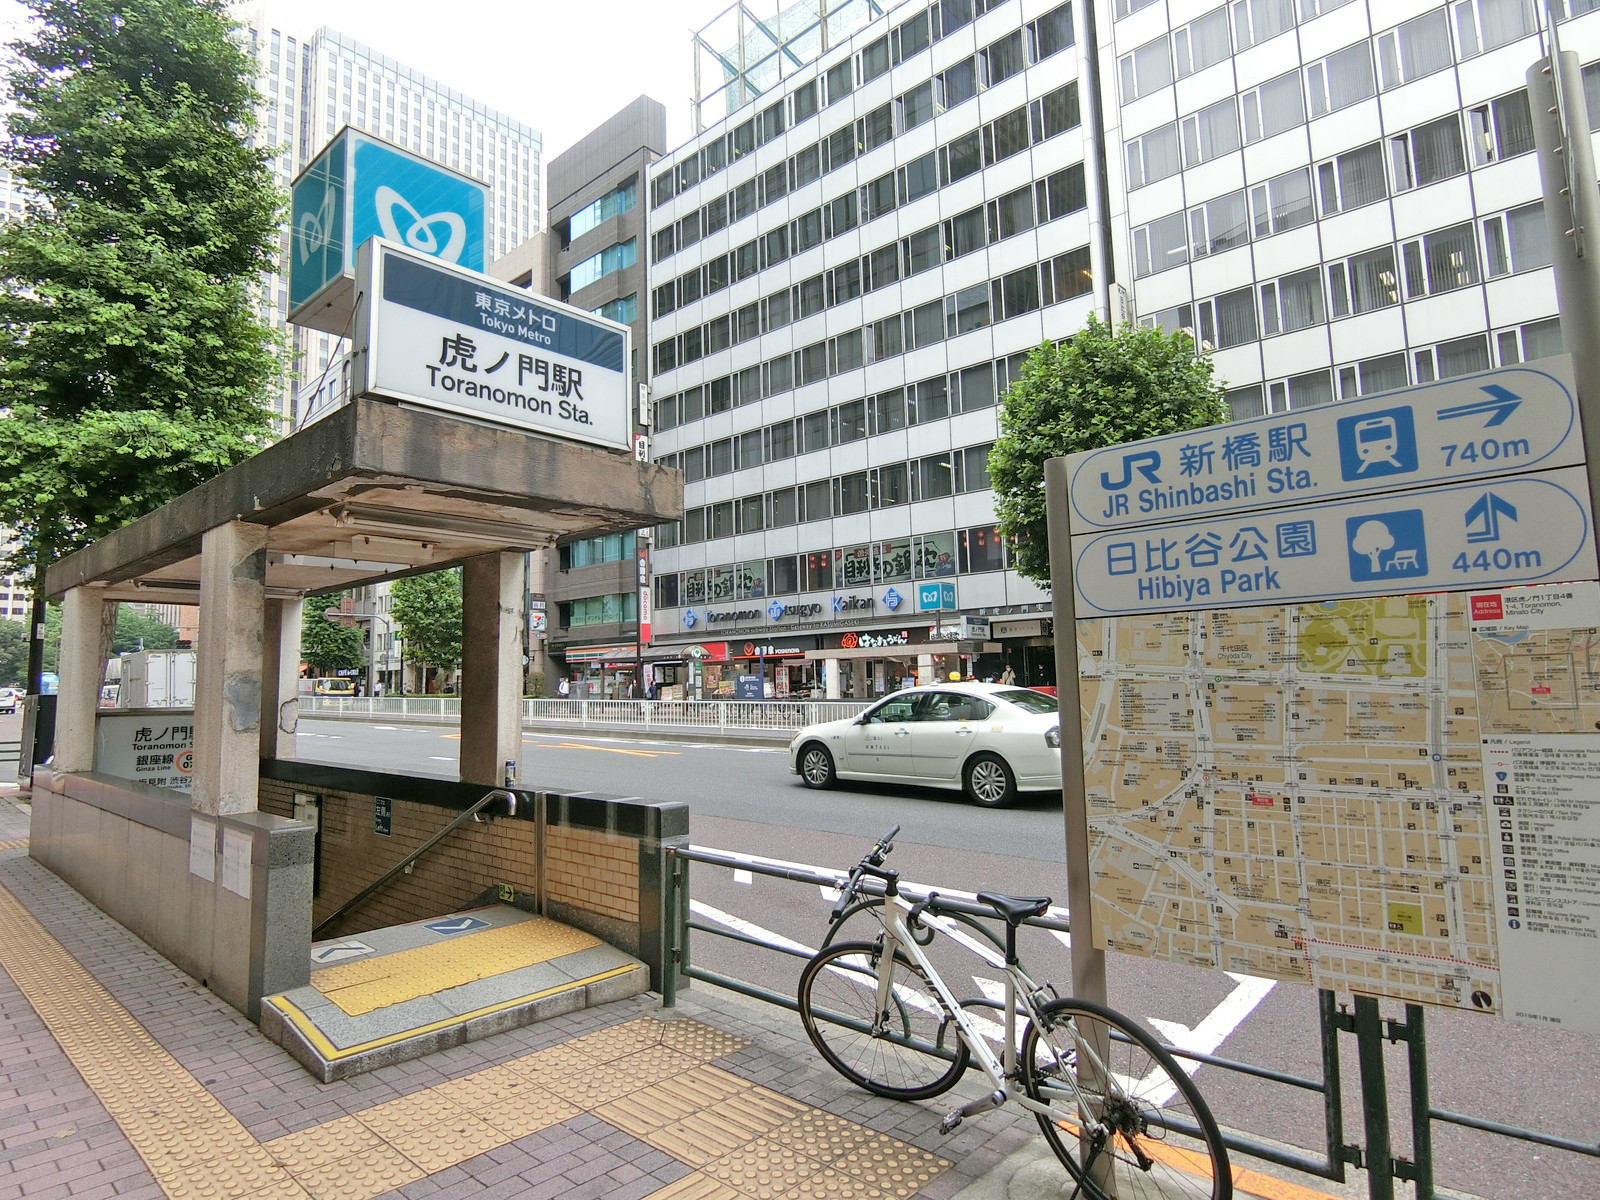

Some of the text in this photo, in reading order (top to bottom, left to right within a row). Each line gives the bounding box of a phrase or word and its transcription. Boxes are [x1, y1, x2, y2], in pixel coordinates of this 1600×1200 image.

[474, 291, 556, 332] 東京メトロ
[480, 312, 551, 345] Tokyo Metro
[438, 332, 584, 401] 虎ノ門駅
[425, 364, 593, 426] Toranomon Sta.
[1100, 423, 1311, 490] JR 新橋駅
[1440, 438, 1530, 467] 740m
[1102, 467, 1318, 519] JR Shinbashi Sta.
[1107, 520, 1317, 576] 日比谷公園
[1452, 549, 1542, 573] 440m
[1138, 566, 1281, 602] Hibiya Park
[703, 608, 760, 624] Toranomon
[831, 595, 875, 612] Kaikan
[132, 742, 187, 751] Toranomon
[136, 754, 174, 766] 銀座線
